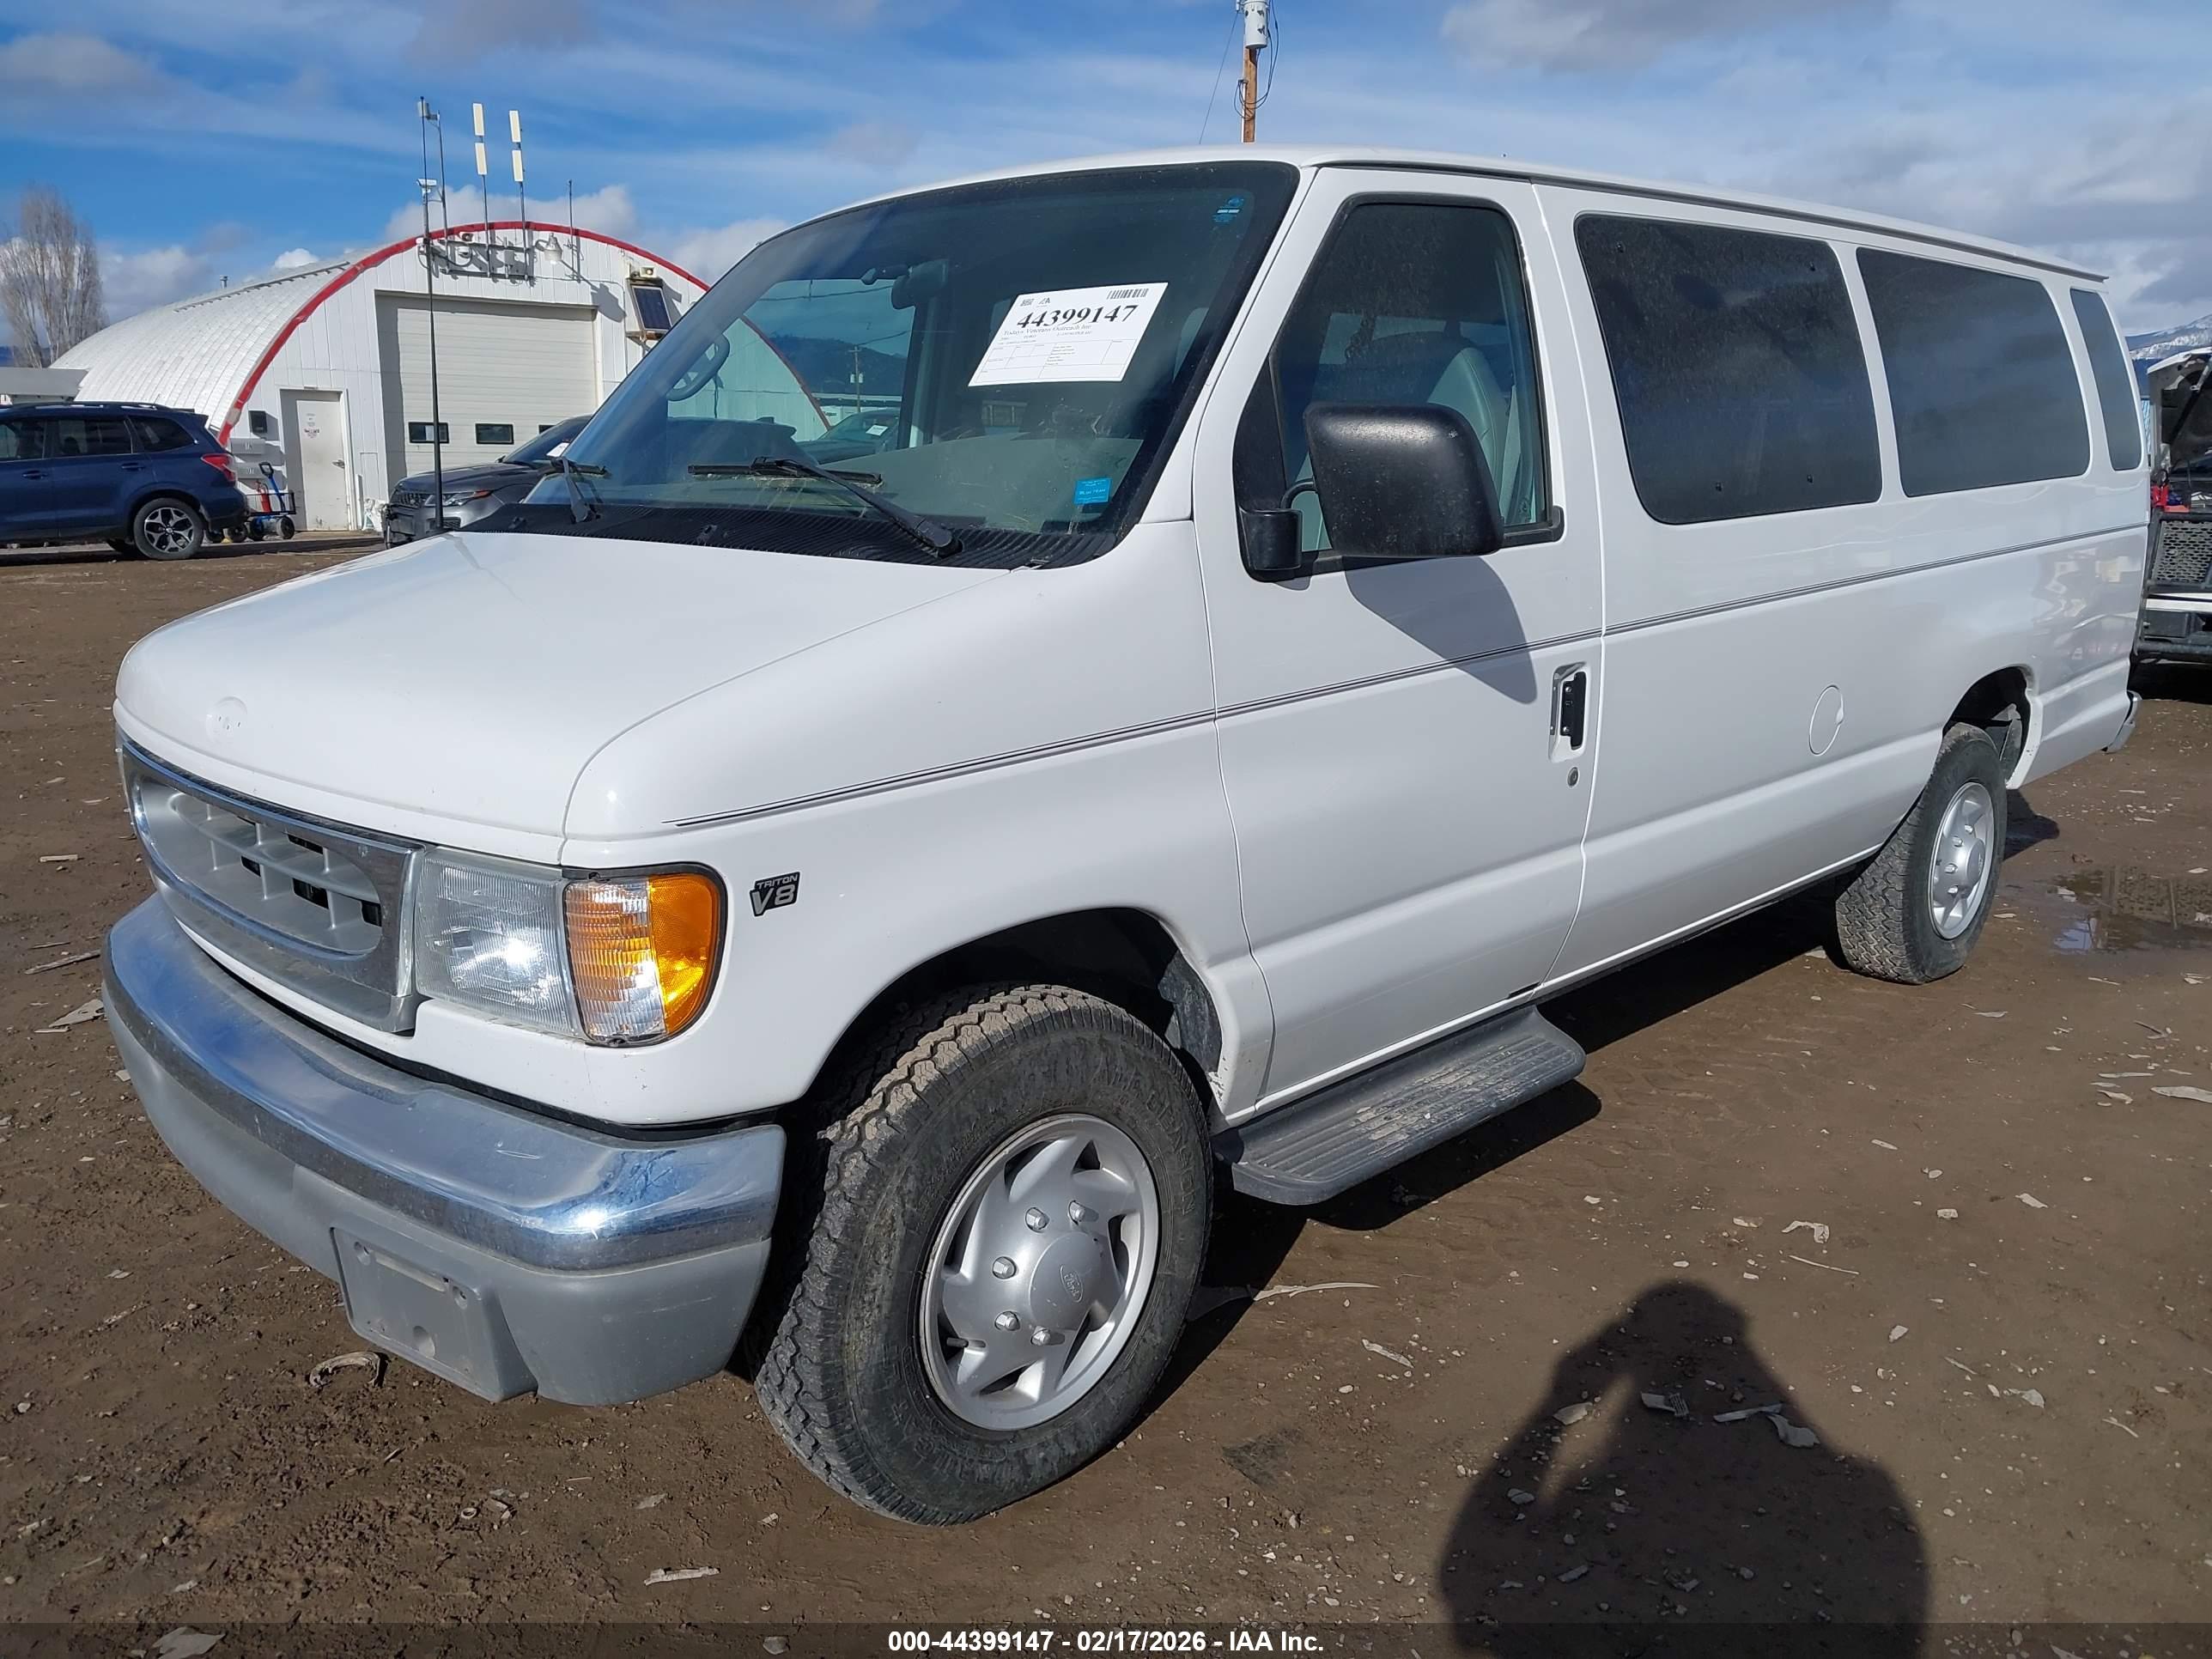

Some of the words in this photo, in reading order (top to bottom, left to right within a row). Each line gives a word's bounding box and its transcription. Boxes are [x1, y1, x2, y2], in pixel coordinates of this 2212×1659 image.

[1017, 304, 1139, 329] 44399147
[756, 874, 799, 890] TRITON
[751, 884, 796, 915] V8
